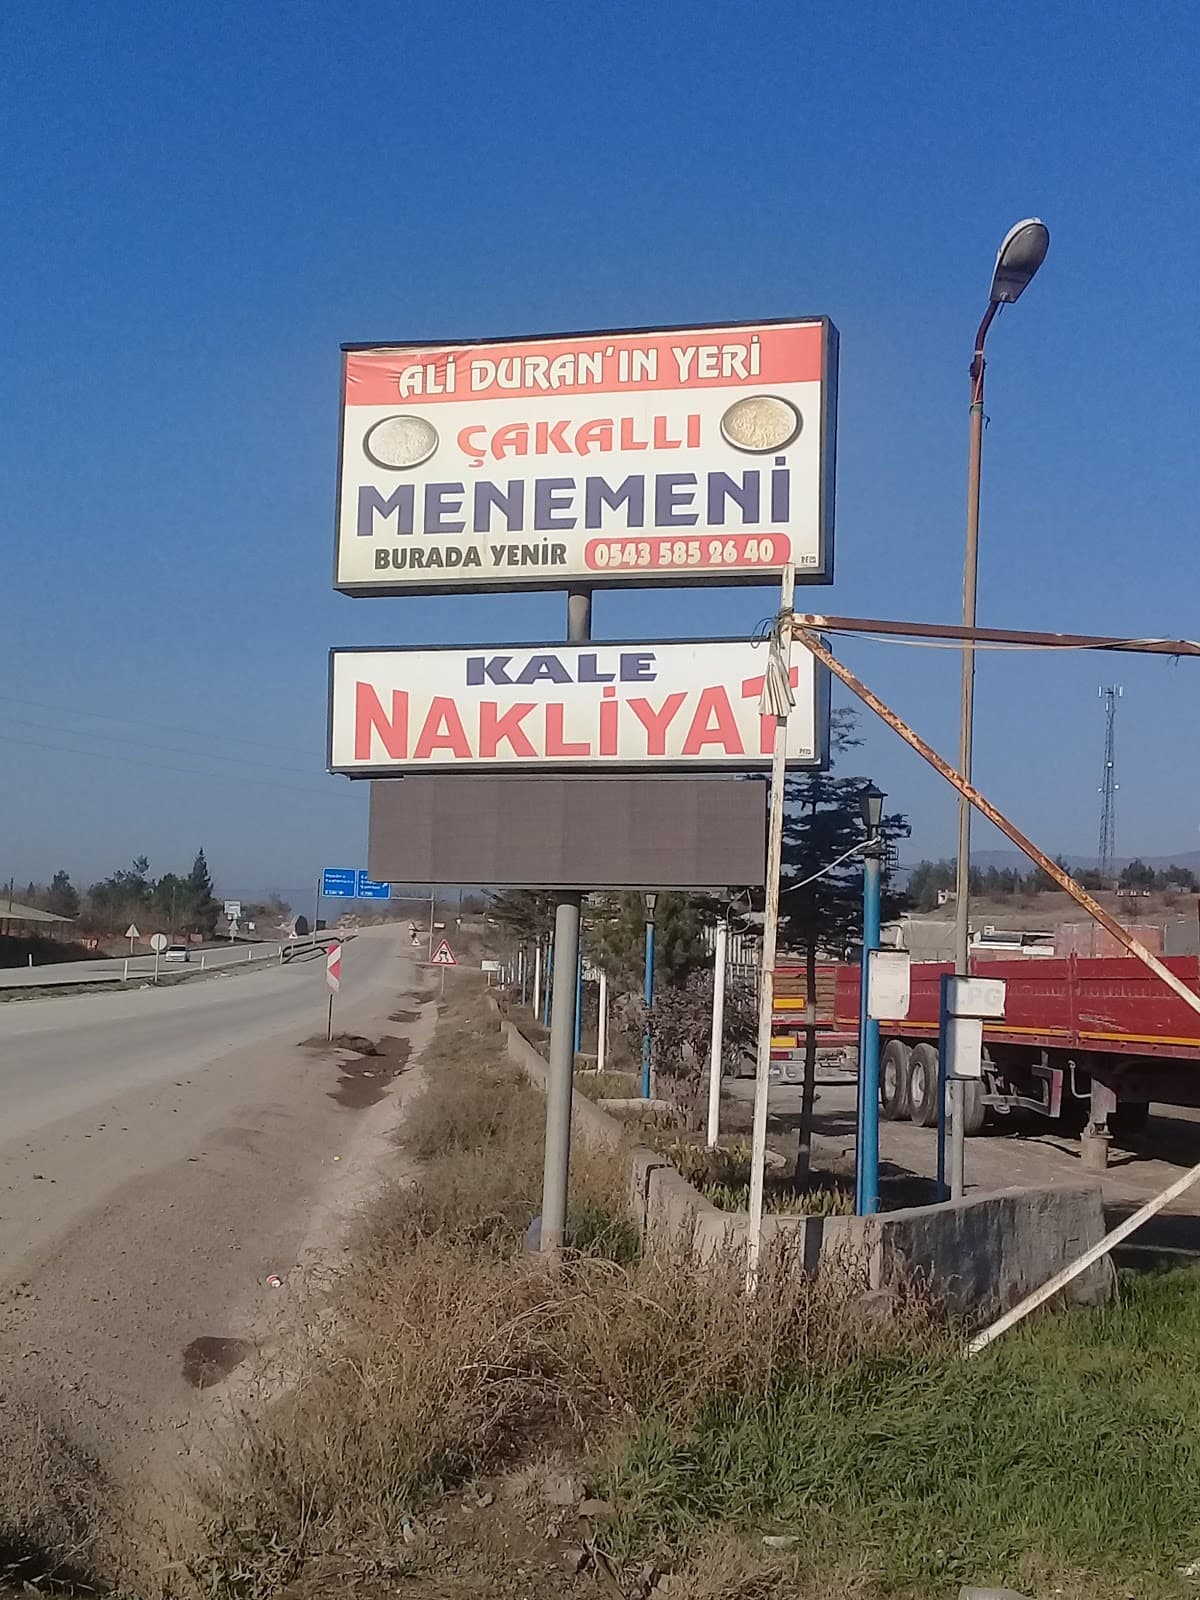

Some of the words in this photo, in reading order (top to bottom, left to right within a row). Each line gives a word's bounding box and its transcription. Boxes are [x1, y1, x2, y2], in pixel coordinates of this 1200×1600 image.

[399, 355, 456, 399] ALİ
[671, 335, 761, 383] YERİ
[457, 414, 701, 468] ÇAKALLI
[356, 456, 791, 537] MENEMENİ
[375, 546, 481, 569] BURADA
[490, 537, 567, 566] YENİR
[594, 543, 651, 567] 0543
[658, 543, 701, 565] 585
[708, 541, 738, 564] 26
[744, 539, 775, 563] 40
[466, 653, 657, 686] KALE
[354, 666, 799, 760] NAKLİYAT
